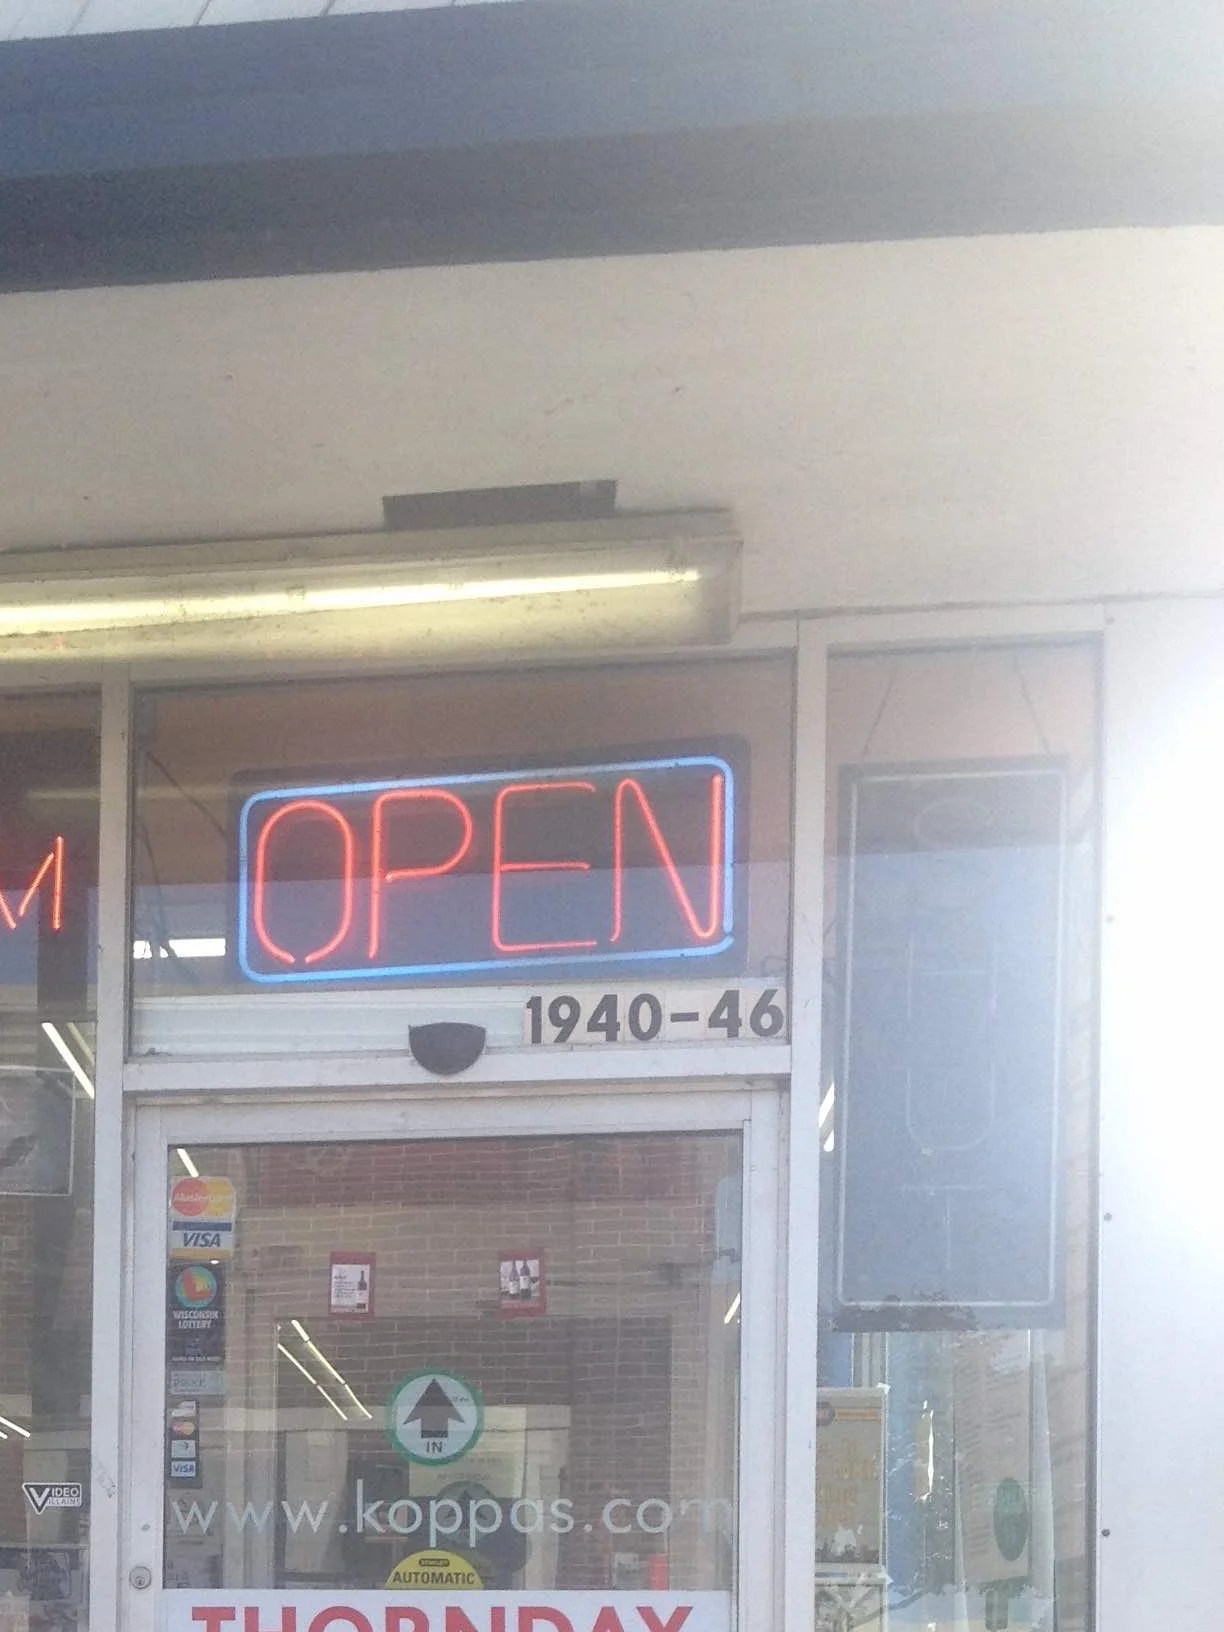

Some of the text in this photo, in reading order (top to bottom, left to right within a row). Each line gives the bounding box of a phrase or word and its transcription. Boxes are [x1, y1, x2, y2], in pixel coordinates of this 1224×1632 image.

[253, 773, 724, 966] OPEN
[525, 988, 784, 1045] 1940-46
[183, 1231, 221, 1248] VISA
[172, 1310, 219, 1320] WISCONSIN
[178, 1319, 212, 1329] LOTTERY
[425, 1440, 443, 1453] IN
[29, 1487, 79, 1507] VIDEO
[172, 1479, 732, 1547] www.koppas.com
[393, 1571, 475, 1585] AUTOMATIC
